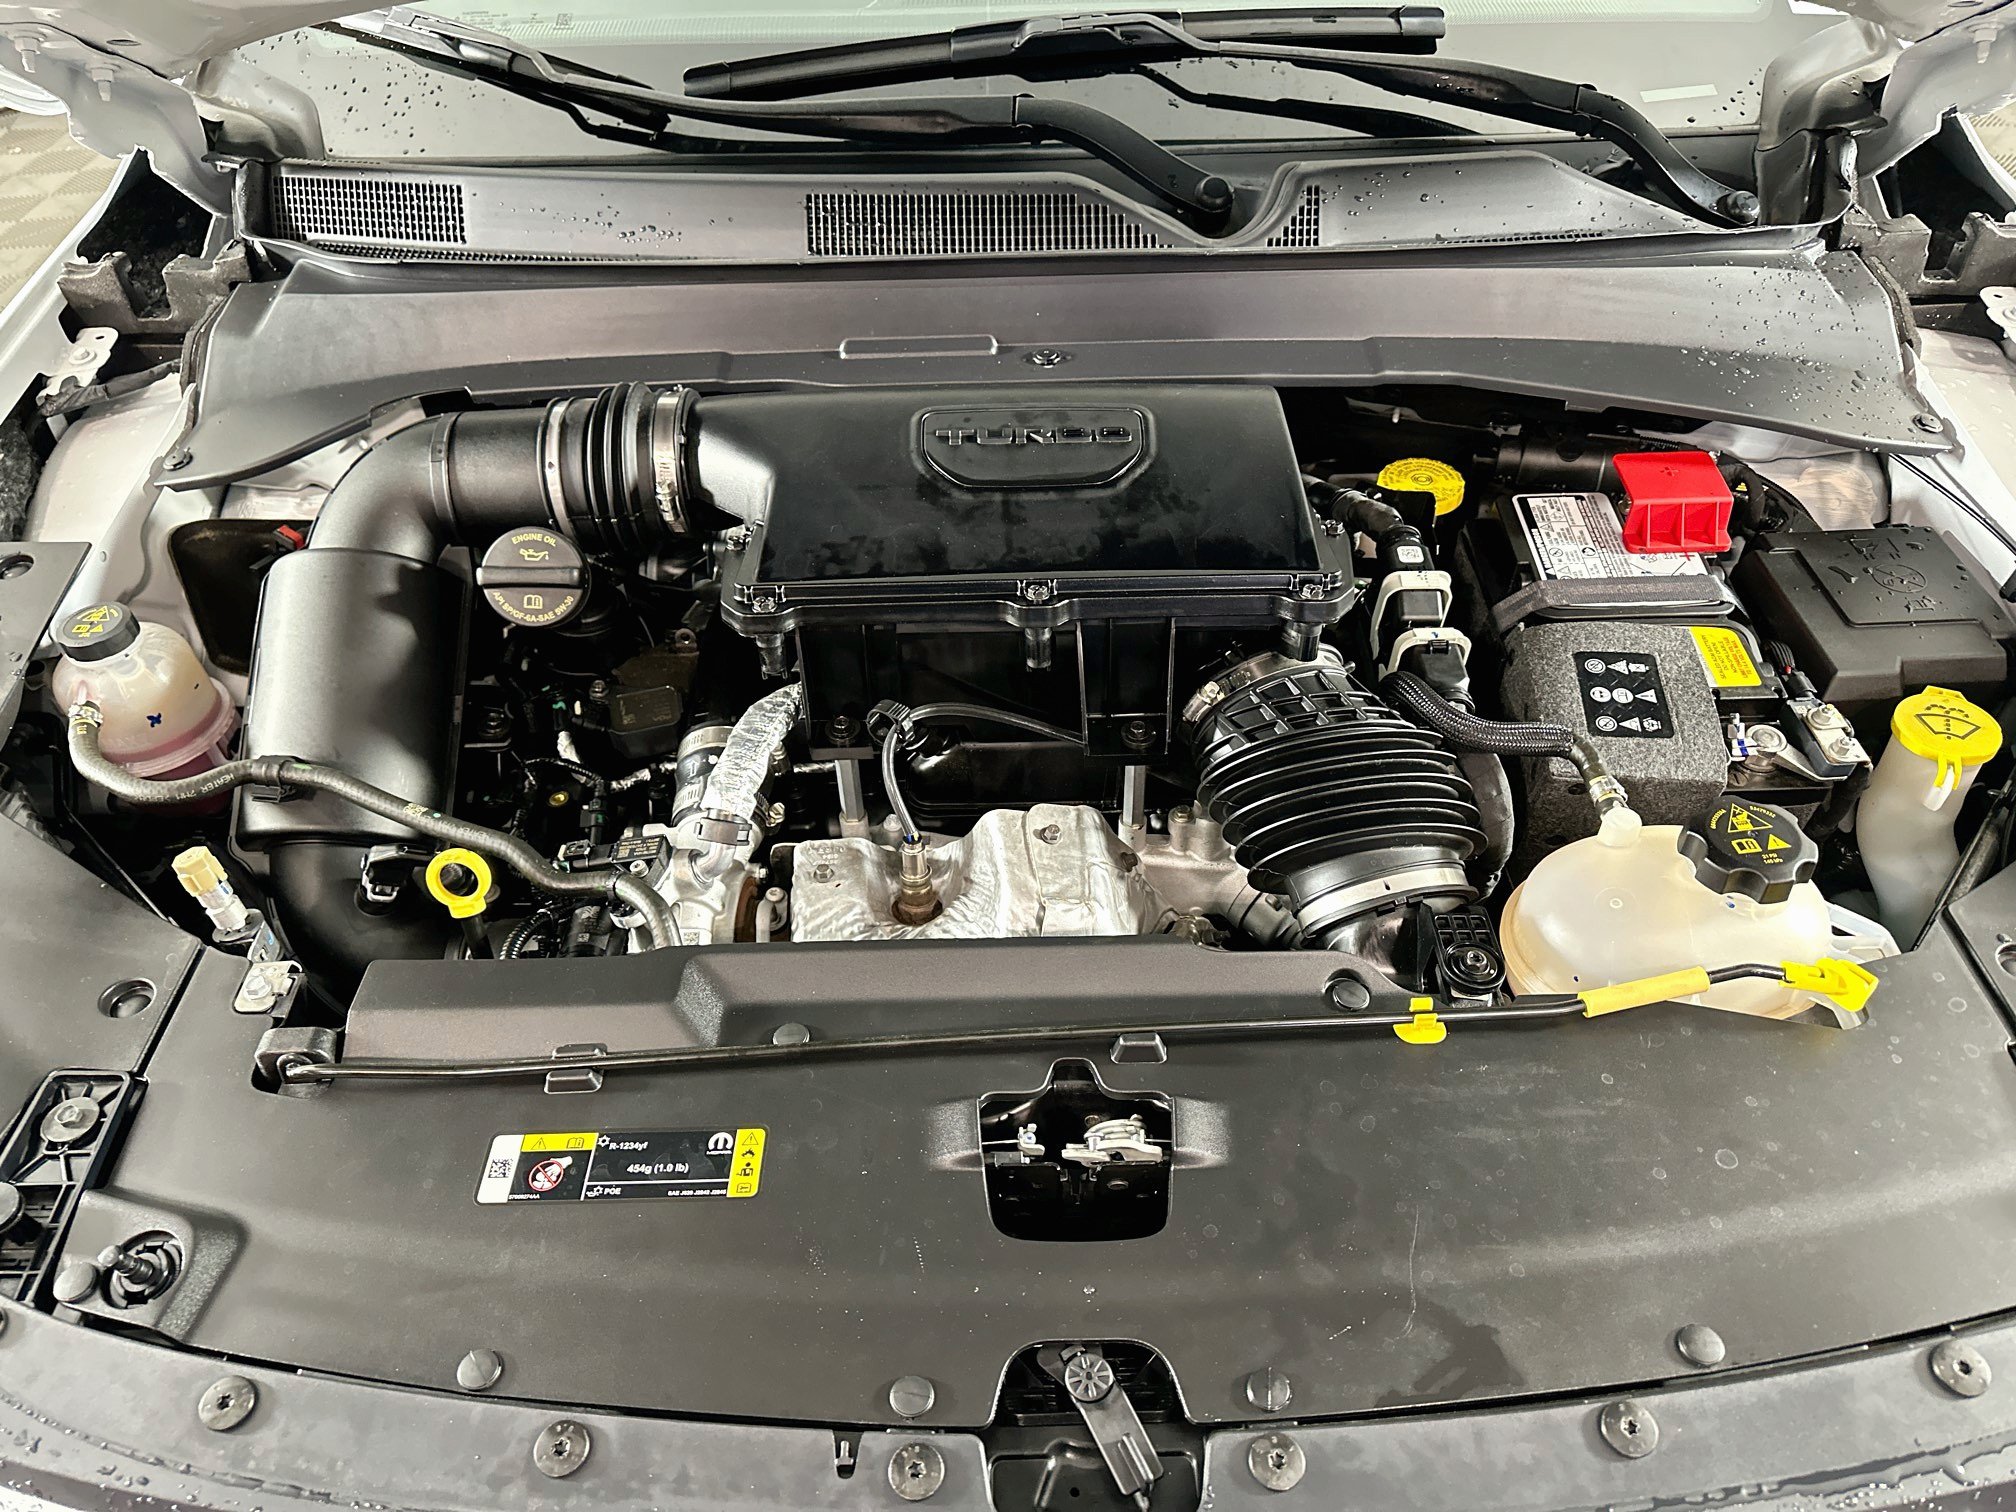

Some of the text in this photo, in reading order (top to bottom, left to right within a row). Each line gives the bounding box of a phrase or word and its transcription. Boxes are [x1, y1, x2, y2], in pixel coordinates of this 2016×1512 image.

[935, 427, 1132, 445] TURBO
[512, 533, 557, 547] ENGINE OIL
[493, 591, 506, 605] API
[554, 595, 575, 615] 5W-30
[201, 772, 235, 794] HEATER
[608, 1141, 648, 1151] R-1234yf
[626, 1162, 690, 1174] 454g (1.0 lb)
[604, 1187, 622, 1196] POE
